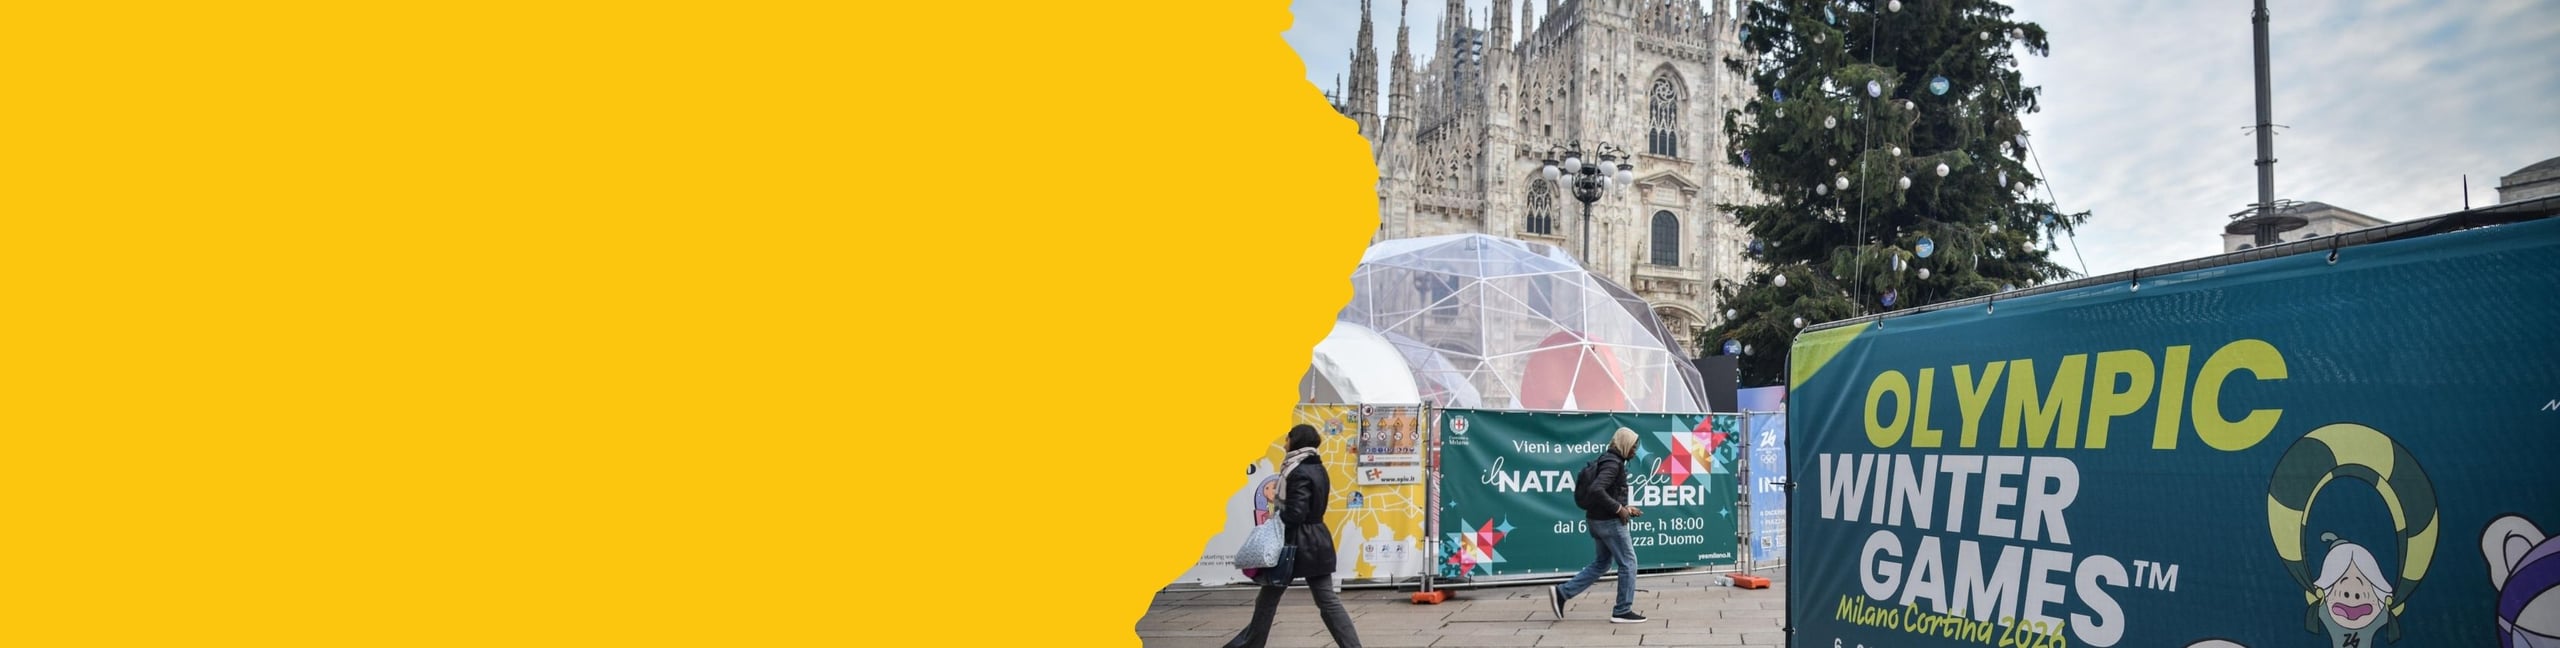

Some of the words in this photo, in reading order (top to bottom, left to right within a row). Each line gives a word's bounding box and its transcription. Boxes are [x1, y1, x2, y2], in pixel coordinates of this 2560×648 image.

[1864, 339, 2288, 451] OLYMPIC
[1512, 440, 1550, 453] Vieni
[1554, 443, 1562, 453] a
[1481, 456, 1504, 486] il
[1499, 470, 1576, 493] NATA
[1626, 457, 1670, 501] egli
[1758, 475, 1787, 493] INS
[1628, 485, 1704, 506] LBERI
[1819, 453, 2080, 545] WINTER
[1554, 520, 1574, 533] dal
[1578, 520, 1587, 533] 6
[1659, 518, 1667, 530] h
[1671, 517, 1704, 531] 18:00
[1632, 536, 1654, 546] zza
[1658, 533, 1704, 546] Duomo
[1835, 594, 1899, 629] Milano
[1903, 602, 1993, 644] Cortina
[1998, 615, 2066, 648] 2026
